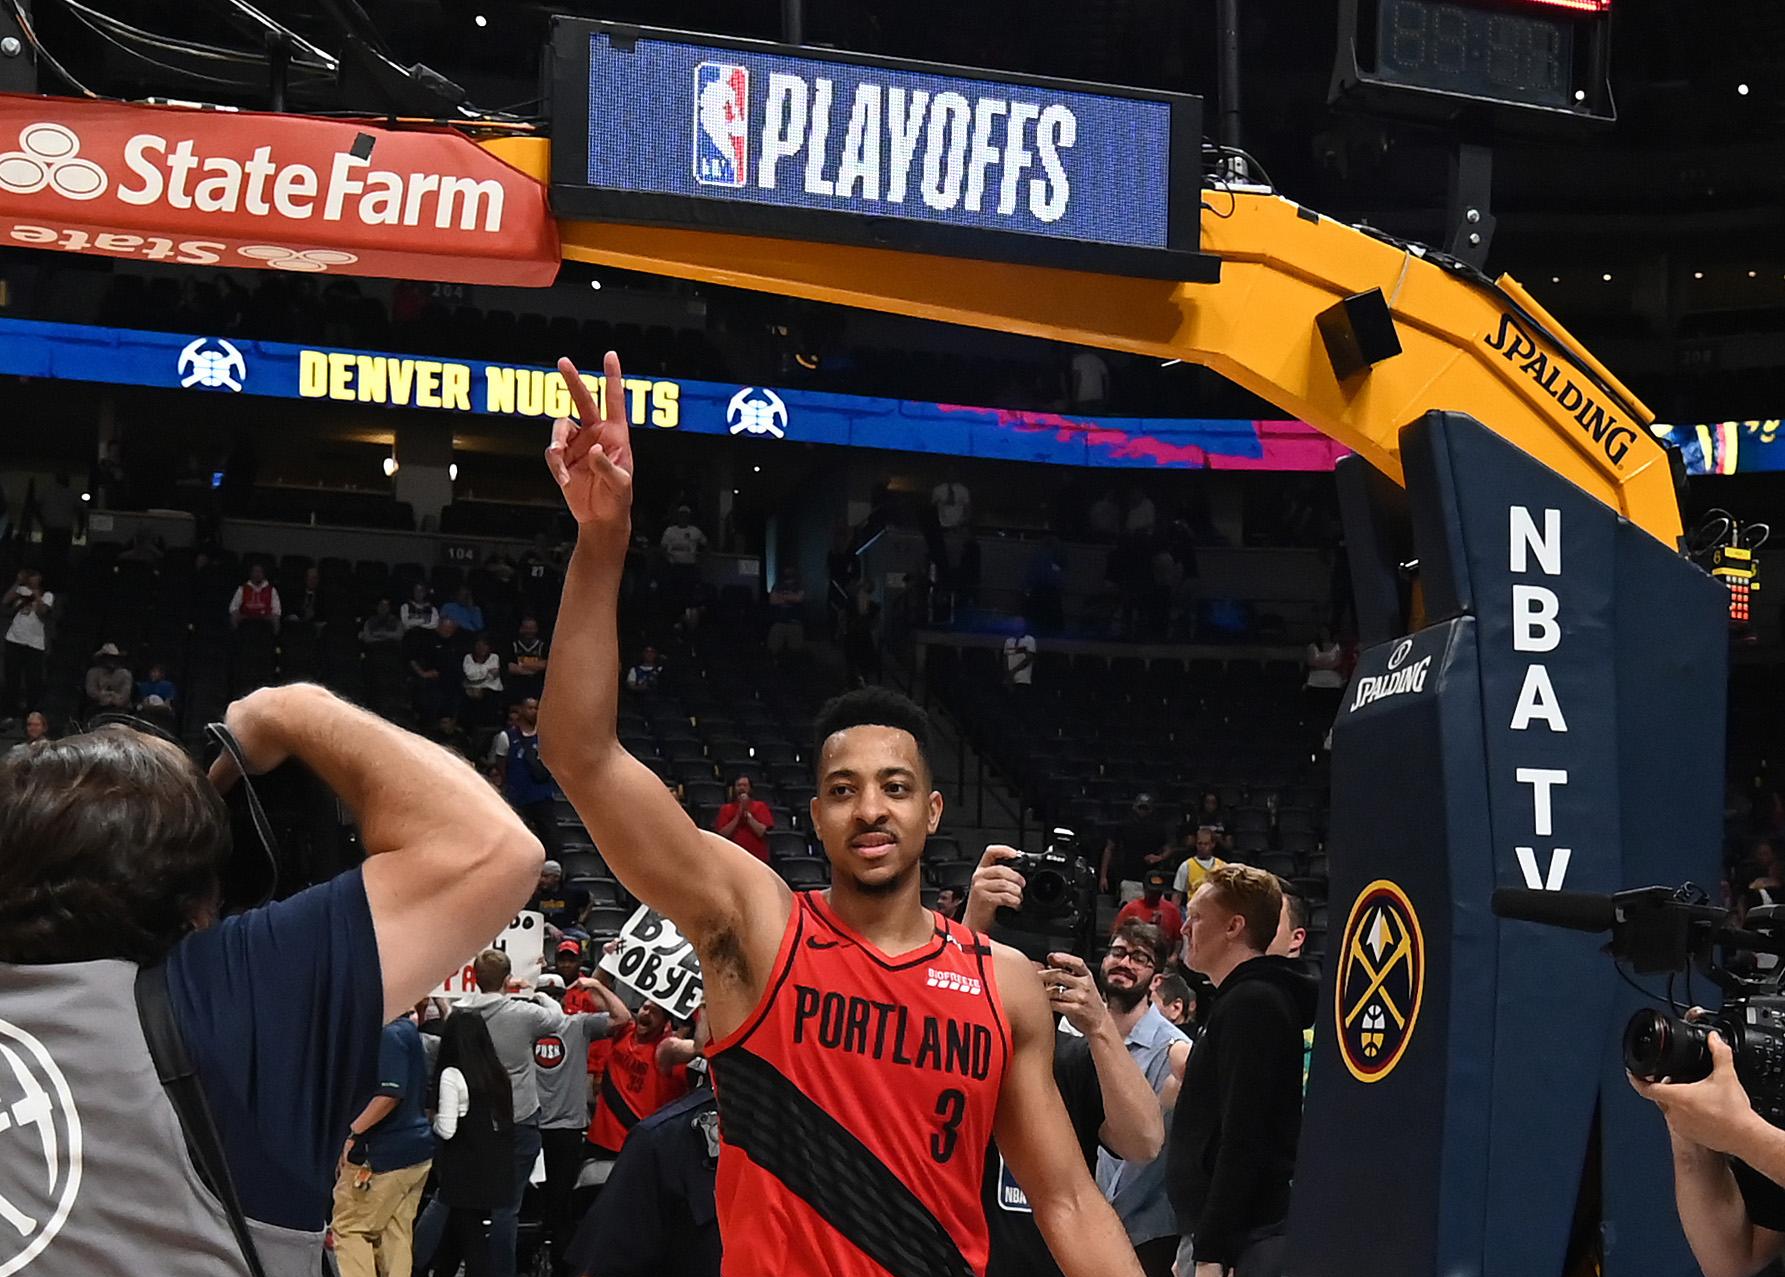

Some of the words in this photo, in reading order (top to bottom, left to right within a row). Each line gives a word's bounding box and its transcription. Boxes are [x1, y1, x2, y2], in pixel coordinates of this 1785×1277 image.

[117, 135, 317, 218] State
[323, 152, 505, 232] Farm
[759, 71, 1077, 222] PLAYOFFS
[299, 350, 471, 411] DENVER
[1484, 313, 1637, 466] SPALDING
[448, 547, 473, 560] 104
[1350, 655, 1432, 713] SPALDING
[794, 984, 992, 1081] PORTLAND
[930, 1088, 966, 1164] 3
